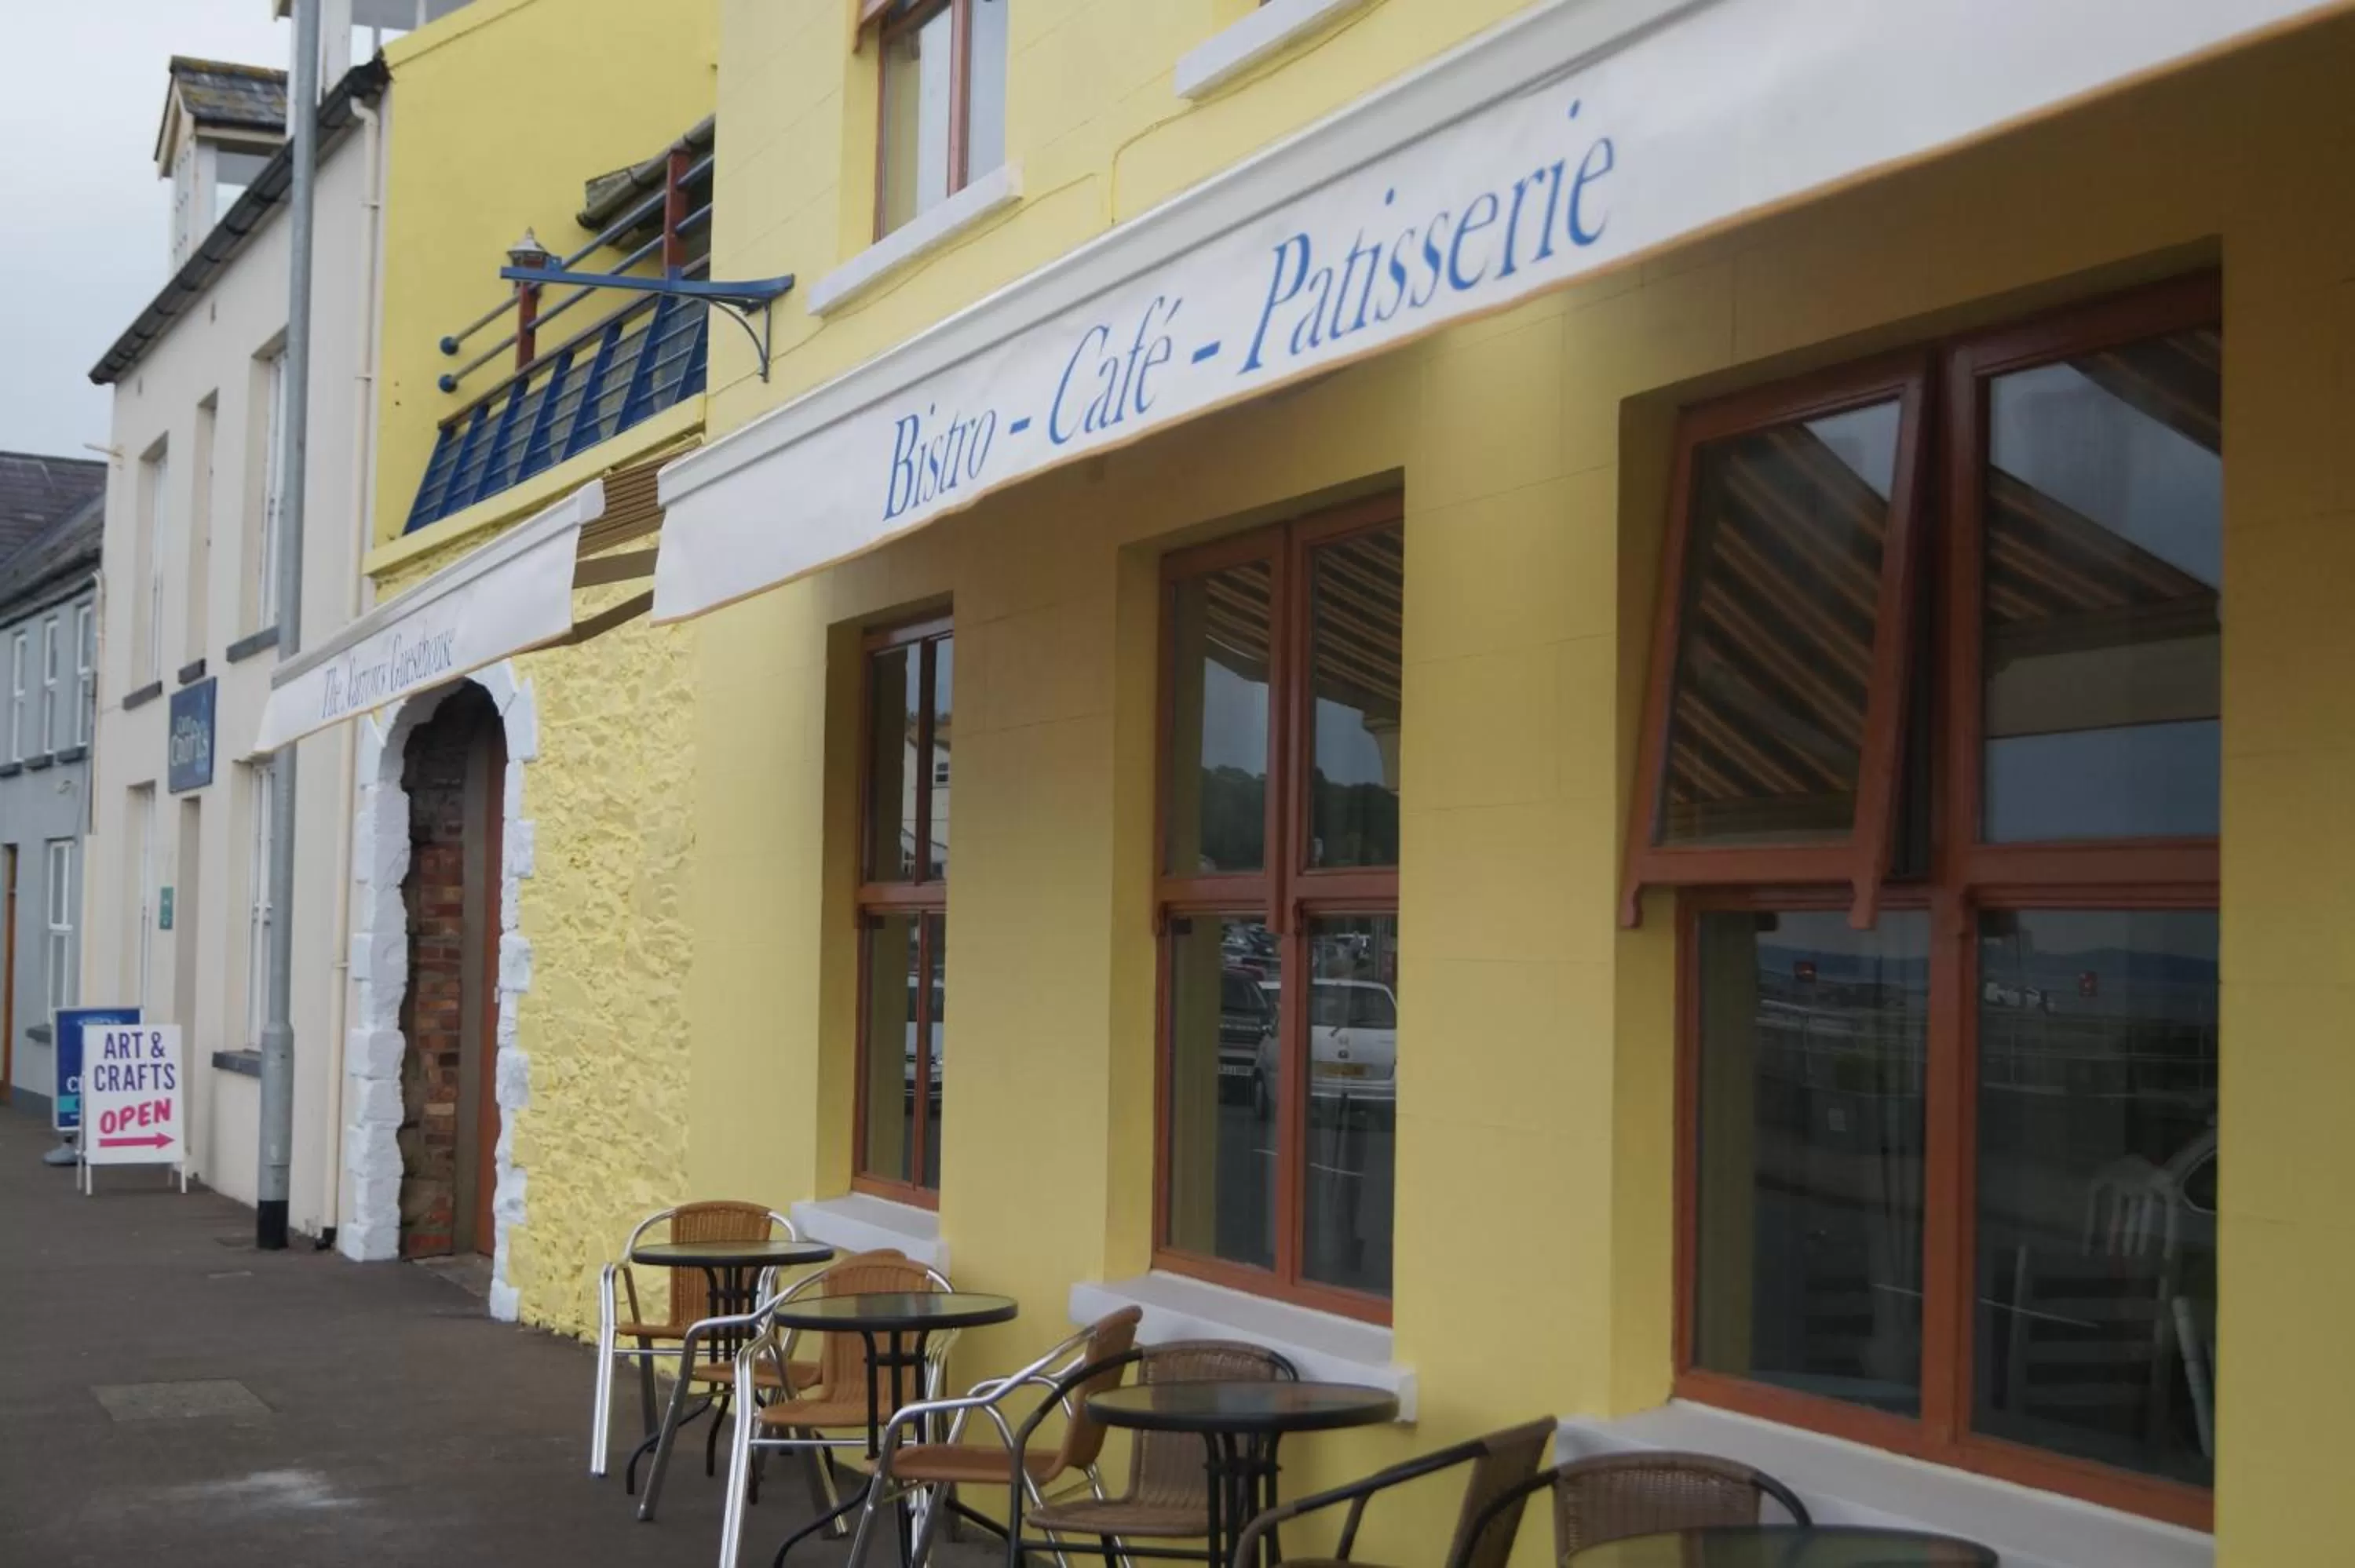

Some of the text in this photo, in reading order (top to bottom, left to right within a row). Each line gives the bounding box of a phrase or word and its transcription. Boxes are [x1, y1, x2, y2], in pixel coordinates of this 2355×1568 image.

[883, 402, 997, 521] Bistro
[1048, 295, 1183, 445] Café
[1236, 98, 1615, 376] Patisserie
[322, 665, 342, 720] The
[103, 1030, 166, 1059] ART &
[93, 1063, 176, 1092] CRAFTS
[100, 1097, 173, 1135] OPEN
